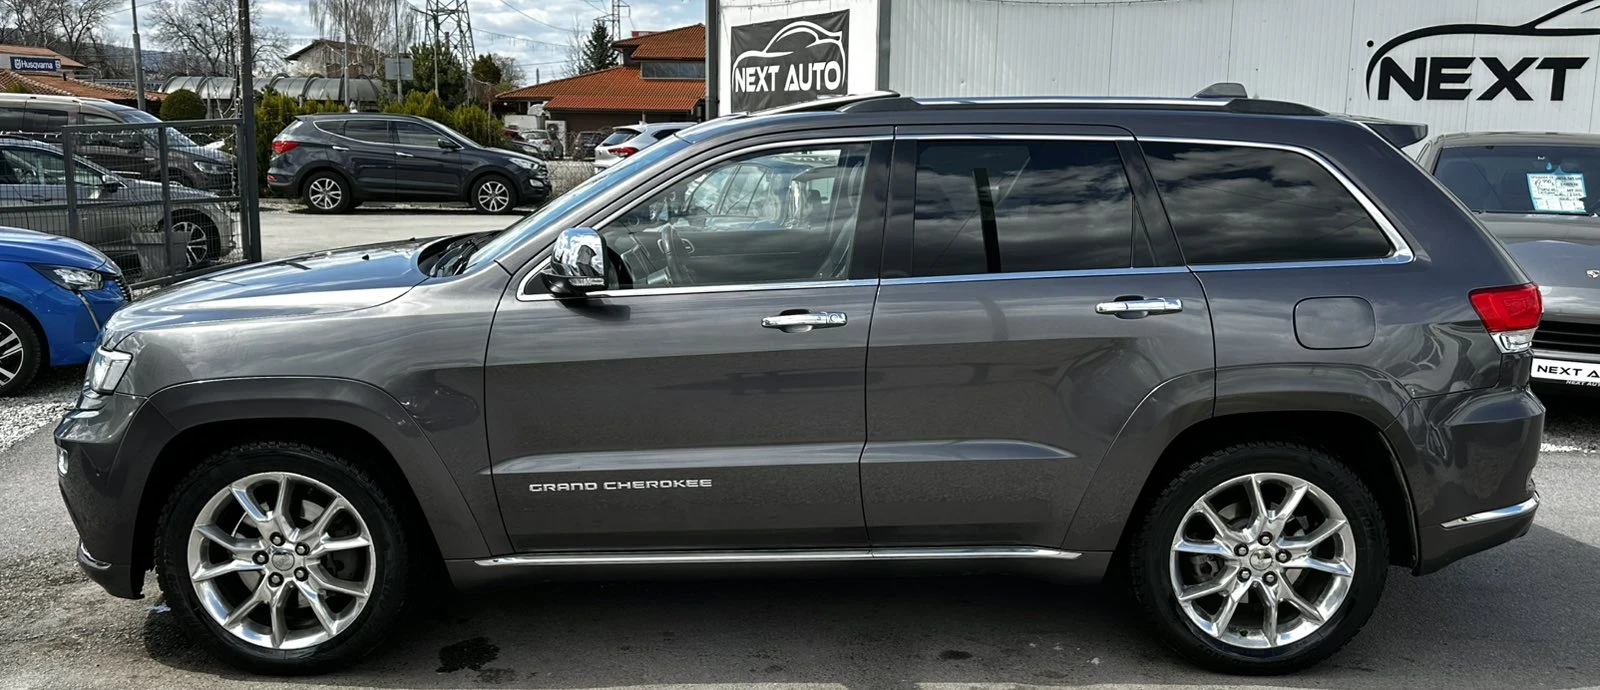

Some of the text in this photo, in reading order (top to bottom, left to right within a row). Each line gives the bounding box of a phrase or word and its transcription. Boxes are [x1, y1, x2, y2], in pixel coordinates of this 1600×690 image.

[21, 60, 53, 69] Husqvarna
[735, 61, 841, 92] NEXT AUTO
[1377, 56, 1590, 101] NEXT
[1537, 364, 1583, 376] NEXT
[529, 479, 713, 492] GRAND CHEROKEE
